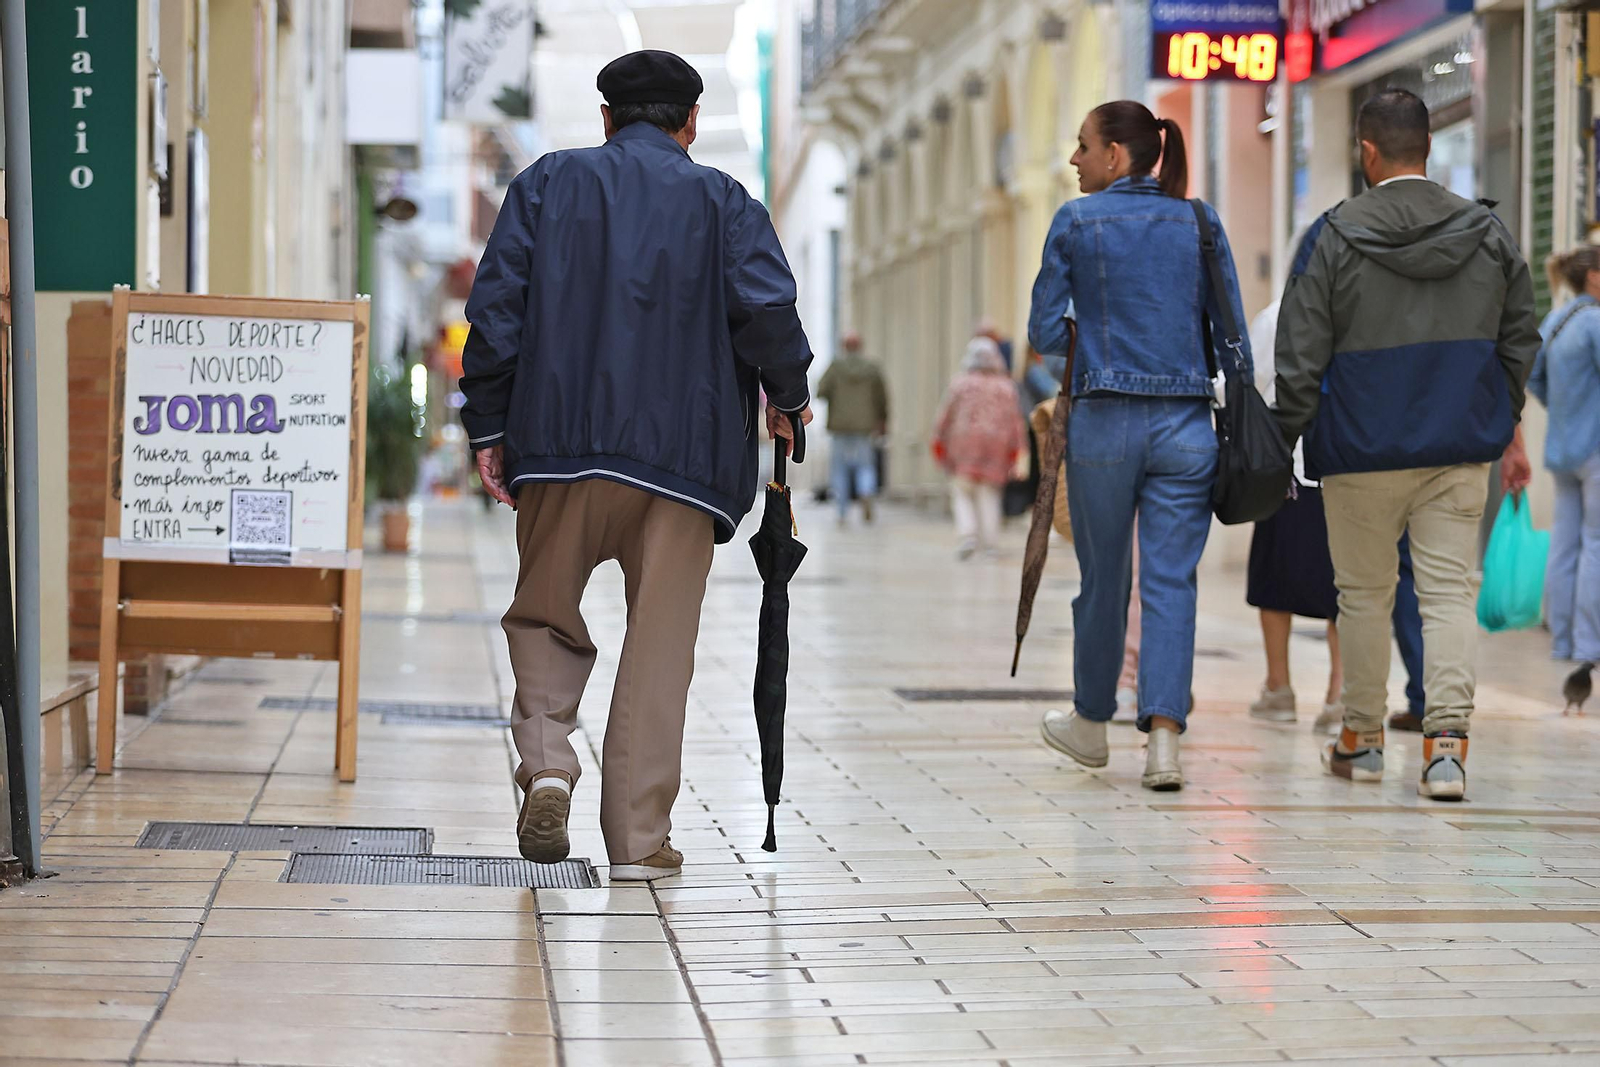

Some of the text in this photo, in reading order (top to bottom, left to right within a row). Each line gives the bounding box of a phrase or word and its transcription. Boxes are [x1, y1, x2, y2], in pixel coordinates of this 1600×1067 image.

[1167, 32, 1278, 81] 10:48
[132, 315, 322, 352] ¿HACES DEPORTE?
[189, 355, 284, 384] NOVEDAD
[289, 394, 327, 406] SPORT
[133, 441, 280, 474] nueva gama de
[134, 459, 340, 492] complementos deportivos
[134, 497, 173, 514] más
[133, 518, 182, 539] ENTRA
